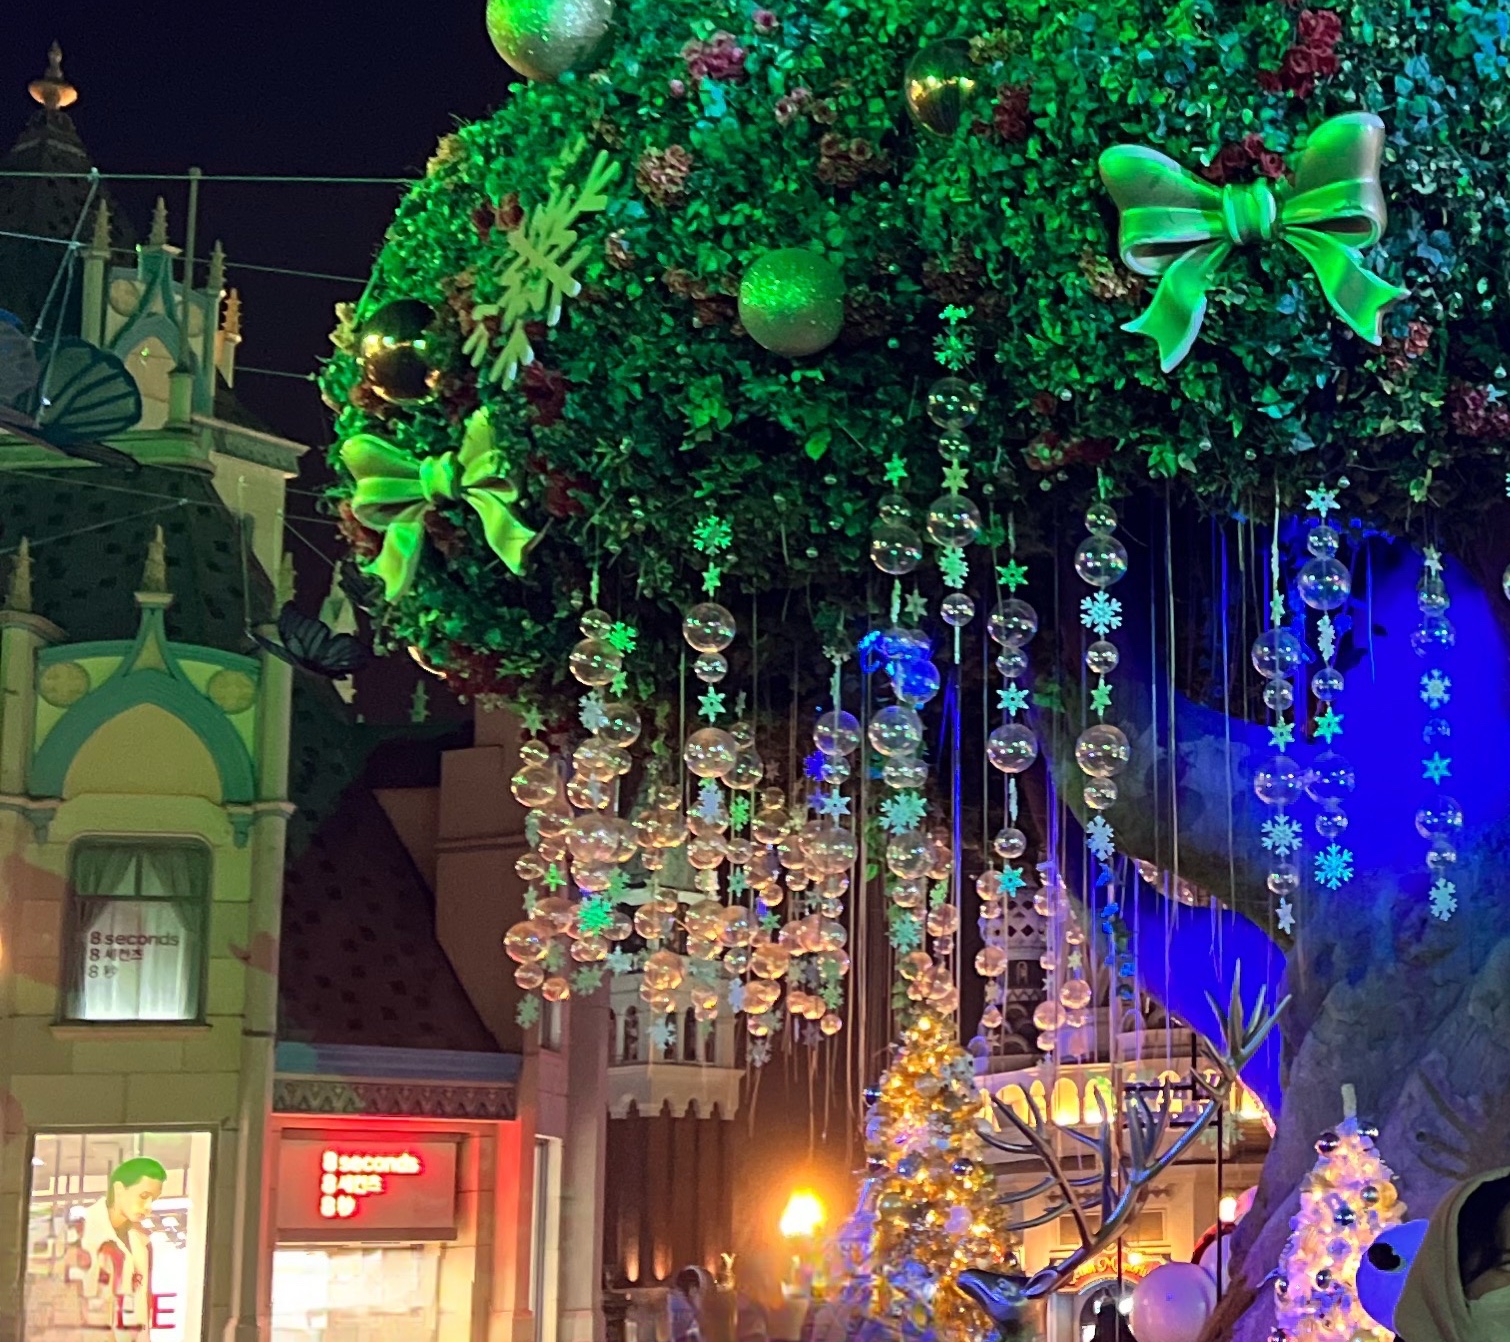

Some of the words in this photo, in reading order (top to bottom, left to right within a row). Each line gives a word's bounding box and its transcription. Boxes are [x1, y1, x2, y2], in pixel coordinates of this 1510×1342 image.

[90, 931, 101, 945] 8
[104, 932, 179, 946] seconds
[89, 948, 100, 962] 8
[88, 965, 99, 978] 8
[322, 1151, 338, 1172] 8
[339, 1152, 420, 1174] seconds
